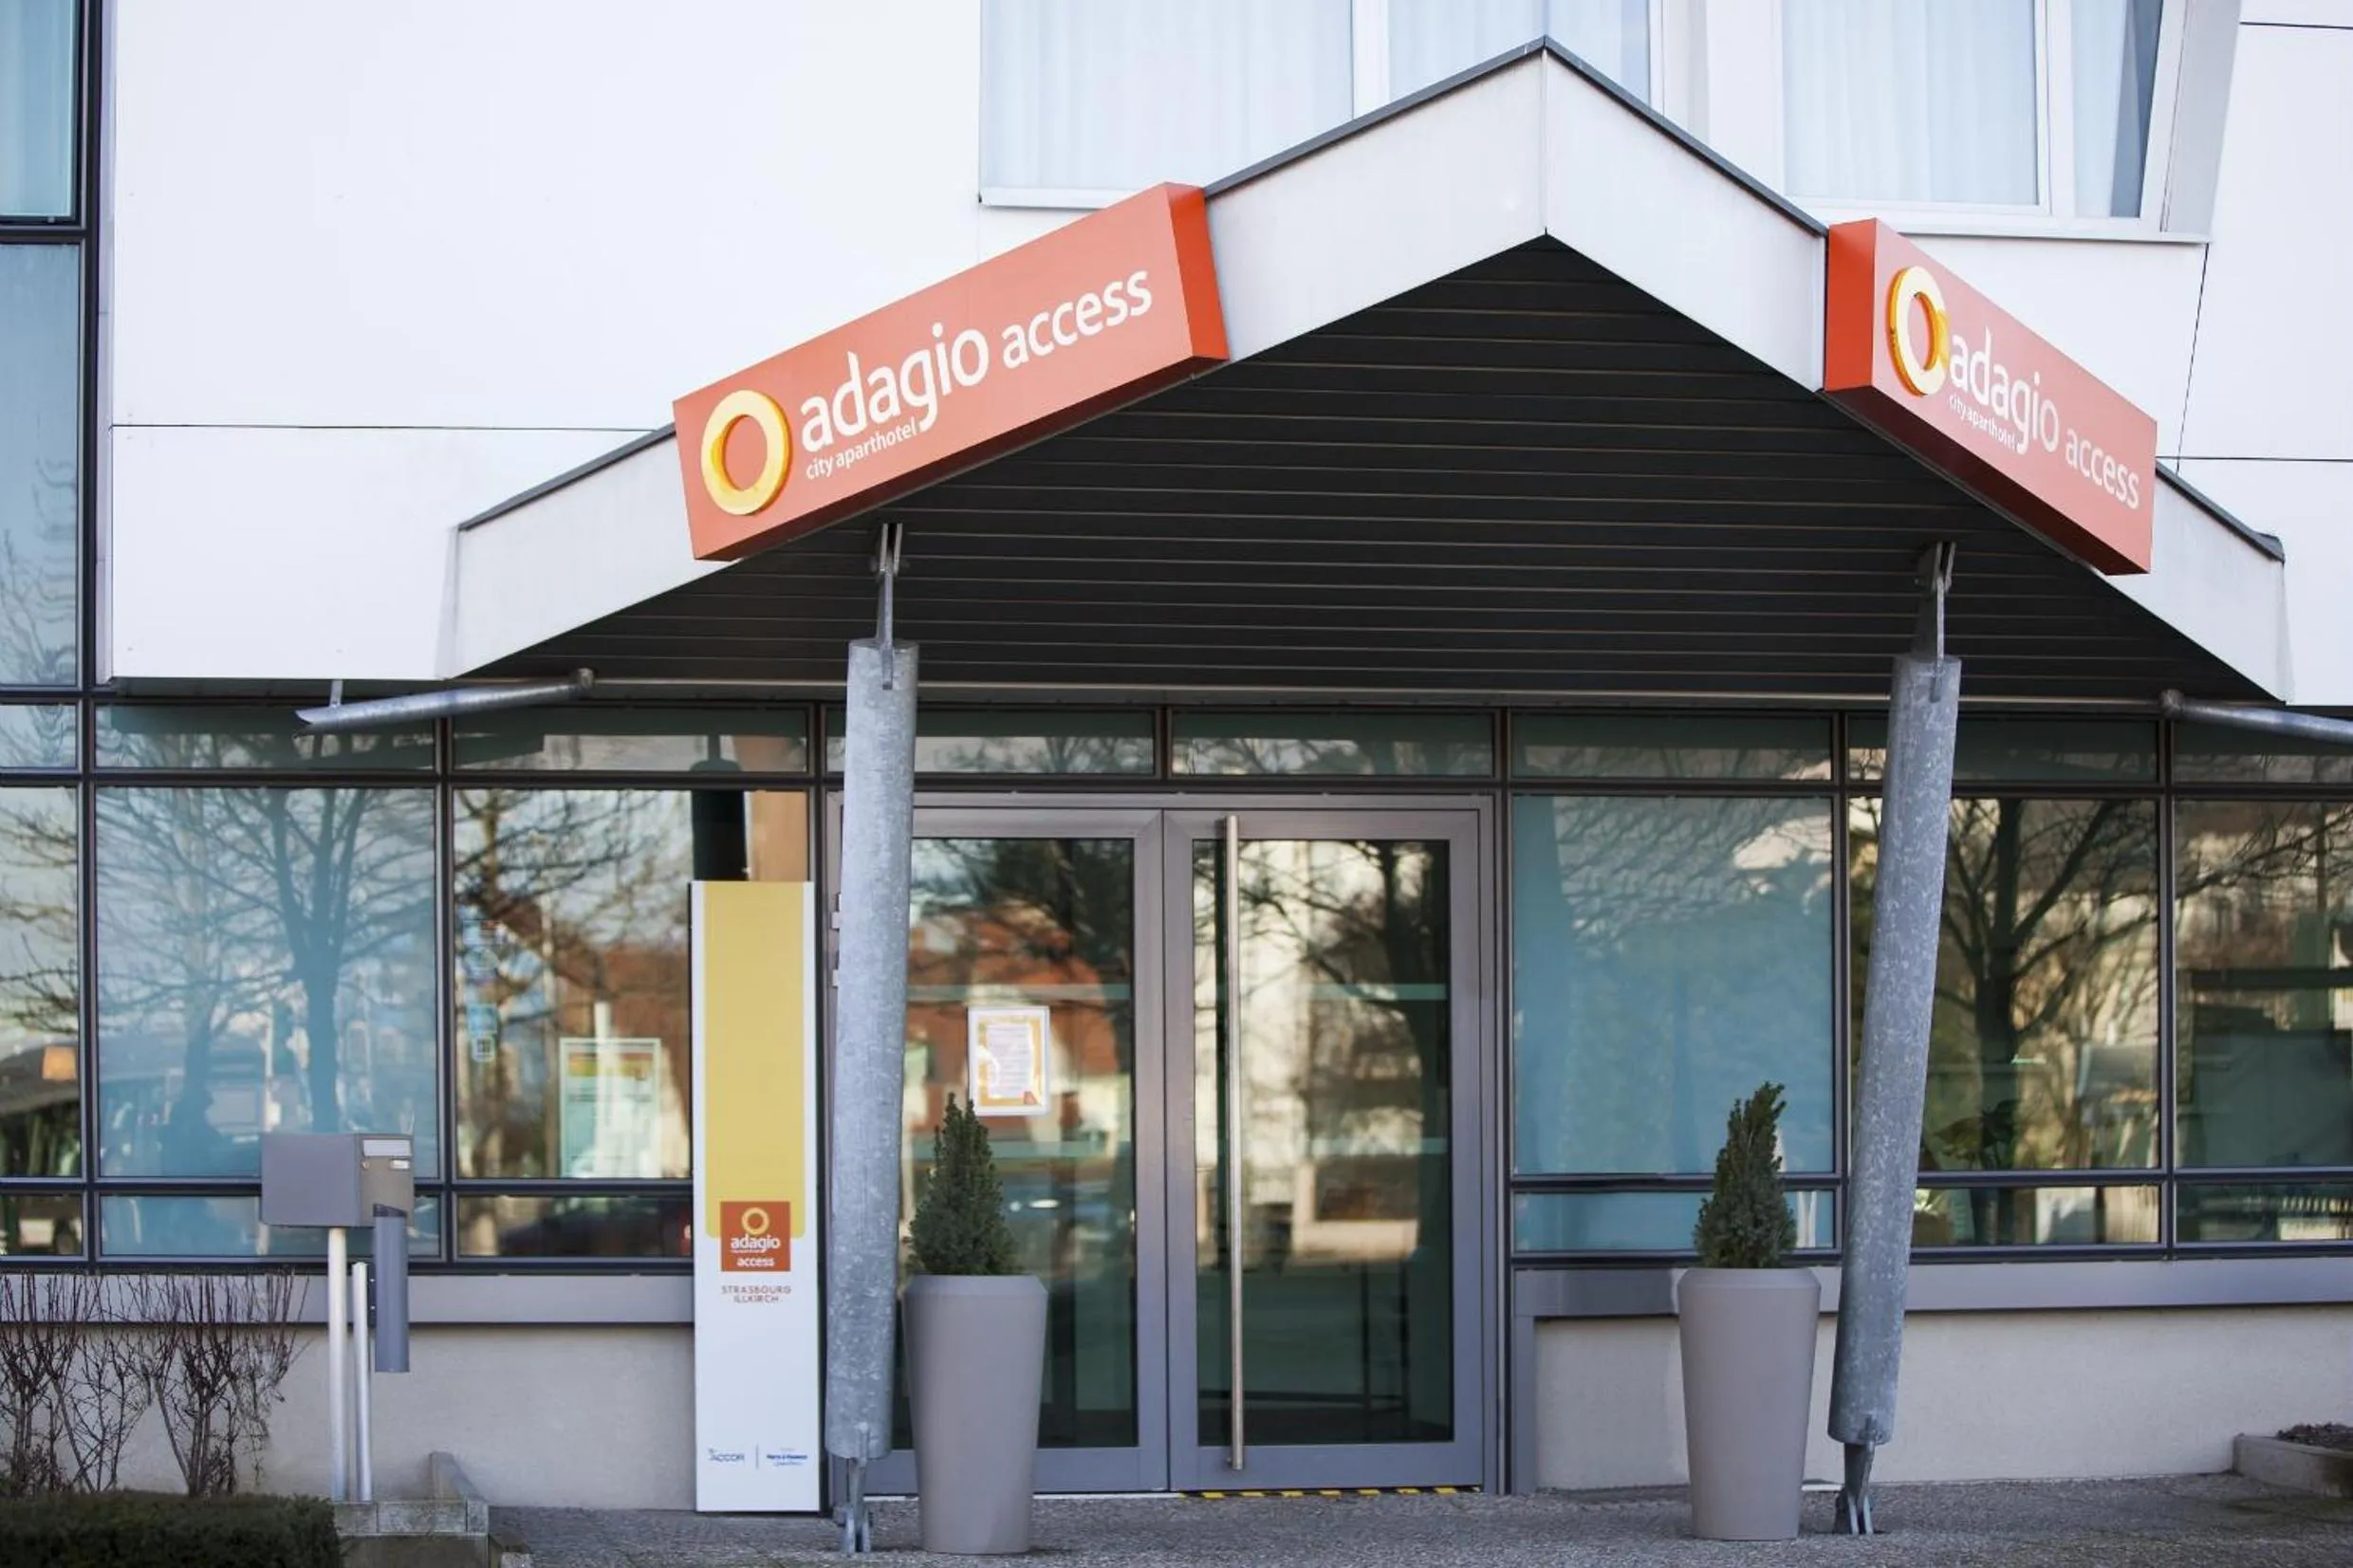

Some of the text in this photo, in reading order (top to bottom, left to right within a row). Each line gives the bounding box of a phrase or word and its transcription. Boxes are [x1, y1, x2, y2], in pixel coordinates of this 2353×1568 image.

[800, 270, 1153, 452] adagio access
[1950, 326, 2140, 509] adagio access
[806, 415, 917, 480] city aparthotel
[730, 1233, 781, 1253] adagio
[736, 1257, 775, 1267] access
[721, 1285, 792, 1294] STRASBOURG
